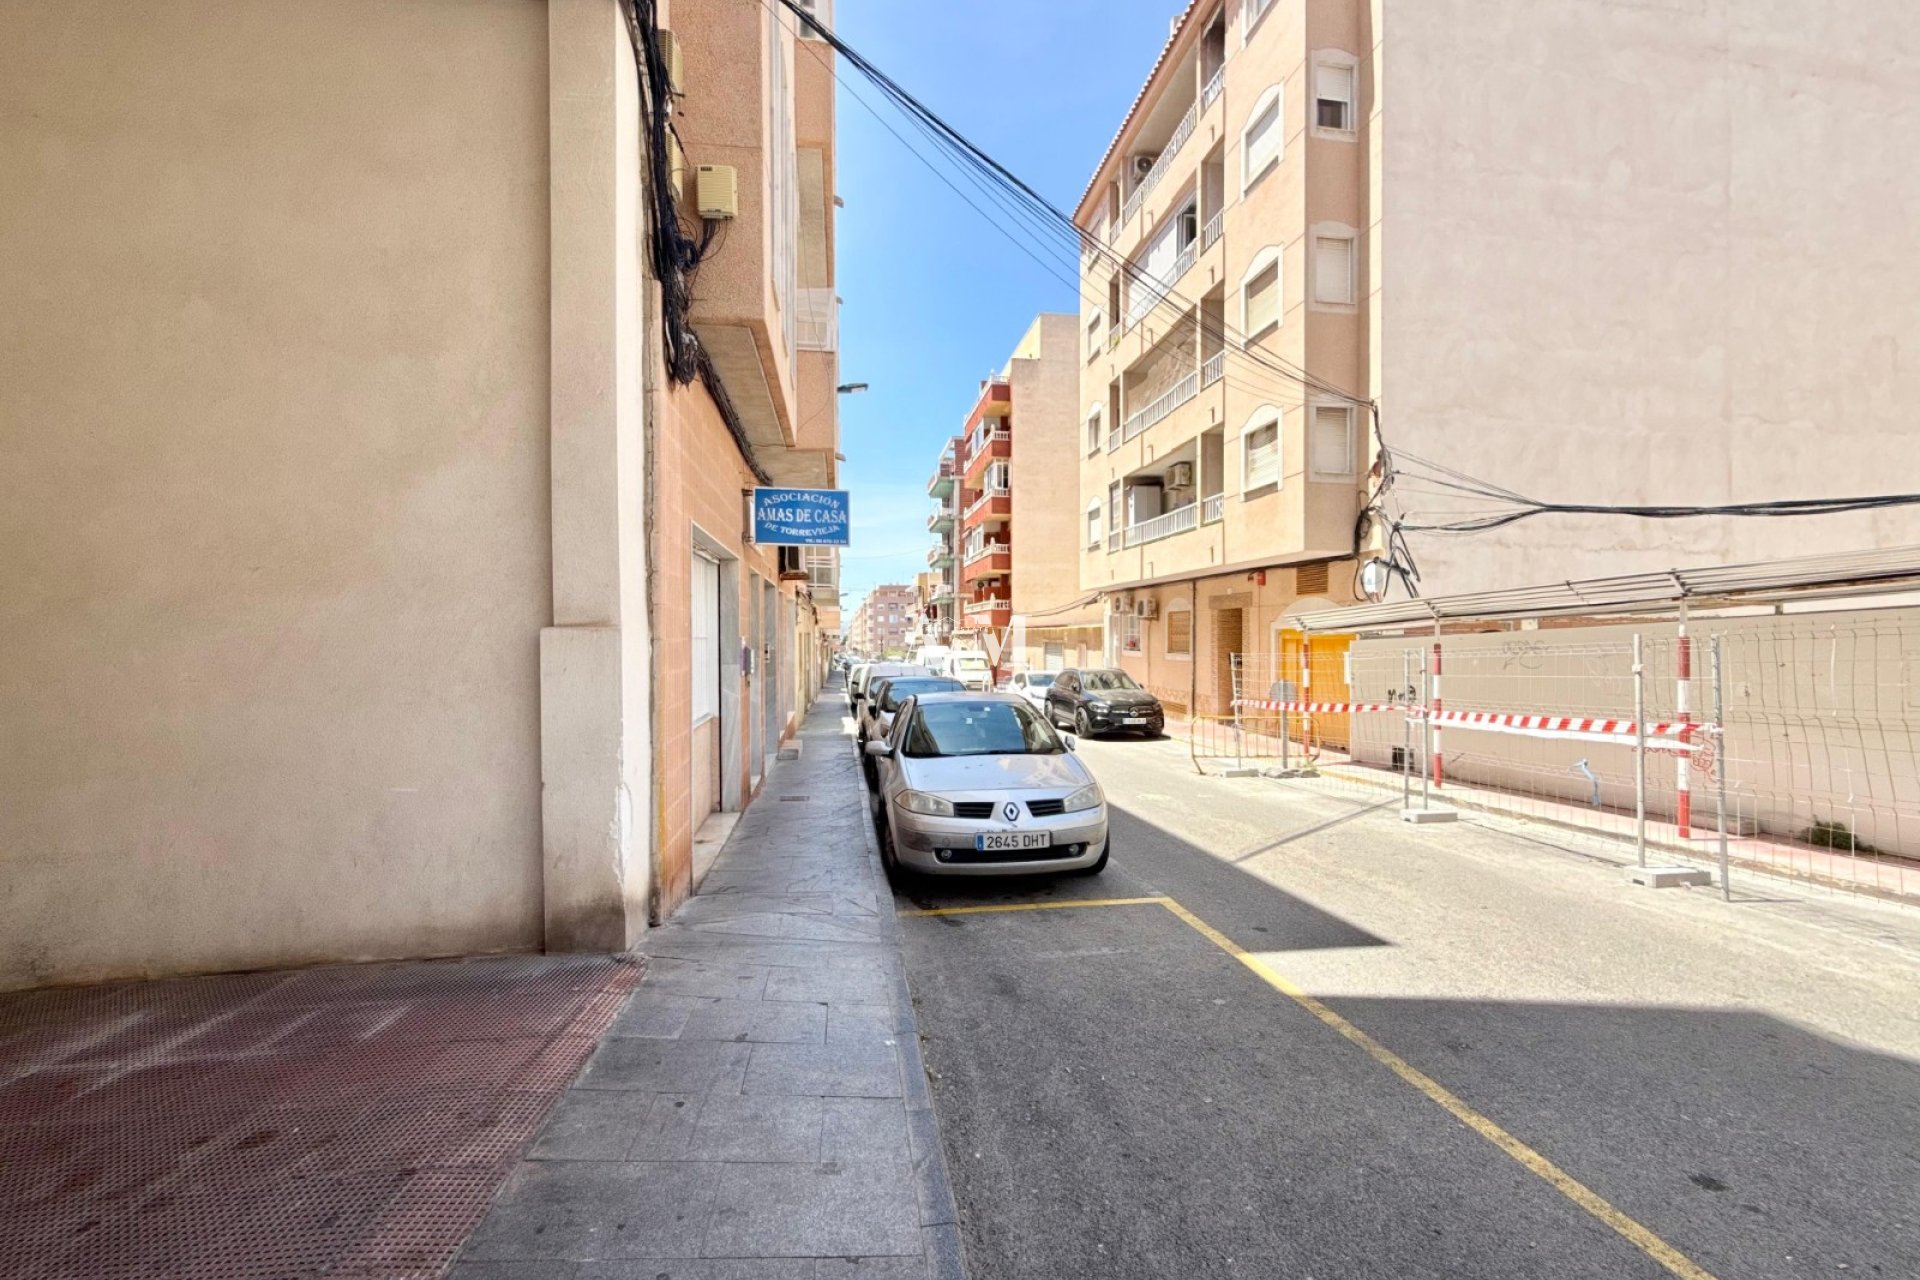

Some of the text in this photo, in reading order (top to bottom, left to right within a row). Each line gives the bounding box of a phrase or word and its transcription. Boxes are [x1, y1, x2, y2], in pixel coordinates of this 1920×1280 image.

[757, 507, 847, 524] AMAS DE CASA
[764, 522, 840, 537] DE TORREVIEJA
[986, 833, 1047, 849] 2645 DHT
